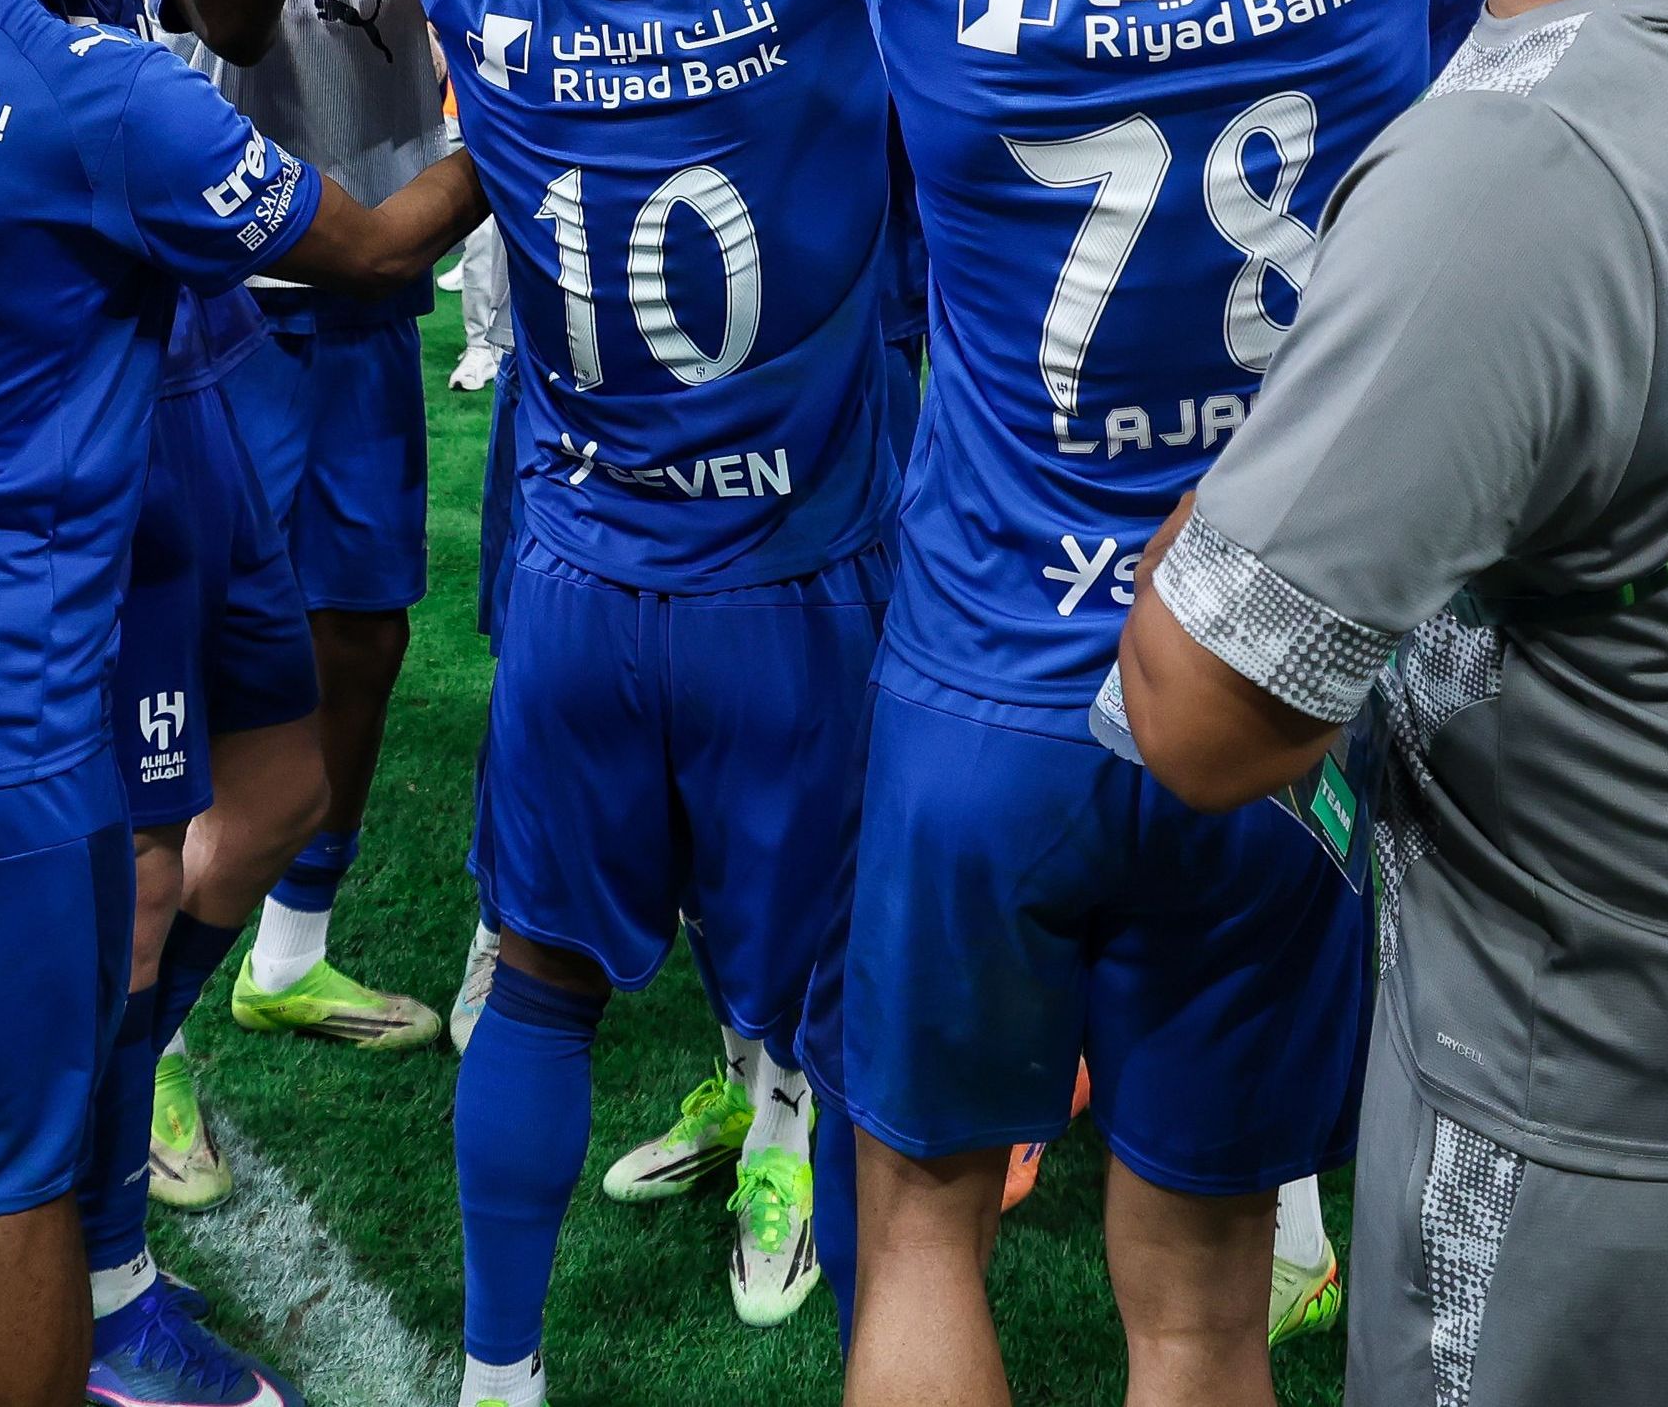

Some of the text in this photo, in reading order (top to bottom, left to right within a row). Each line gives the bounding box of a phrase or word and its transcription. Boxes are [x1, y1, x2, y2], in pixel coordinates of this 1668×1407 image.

[552, 20, 664, 65] الرياض
[1084, 1, 1236, 62] Riyad
[553, 42, 788, 110] Riyad Bank
[534, 165, 762, 392] 10
[999, 90, 1318, 416] 78
[1053, 394, 1256, 460] LAJA
[140, 750, 187, 770] ALHILAL
[142, 763, 184, 783] الهلال
[1322, 778, 1351, 832] TEAM
[1437, 1032, 1485, 1066] DRYCELL
